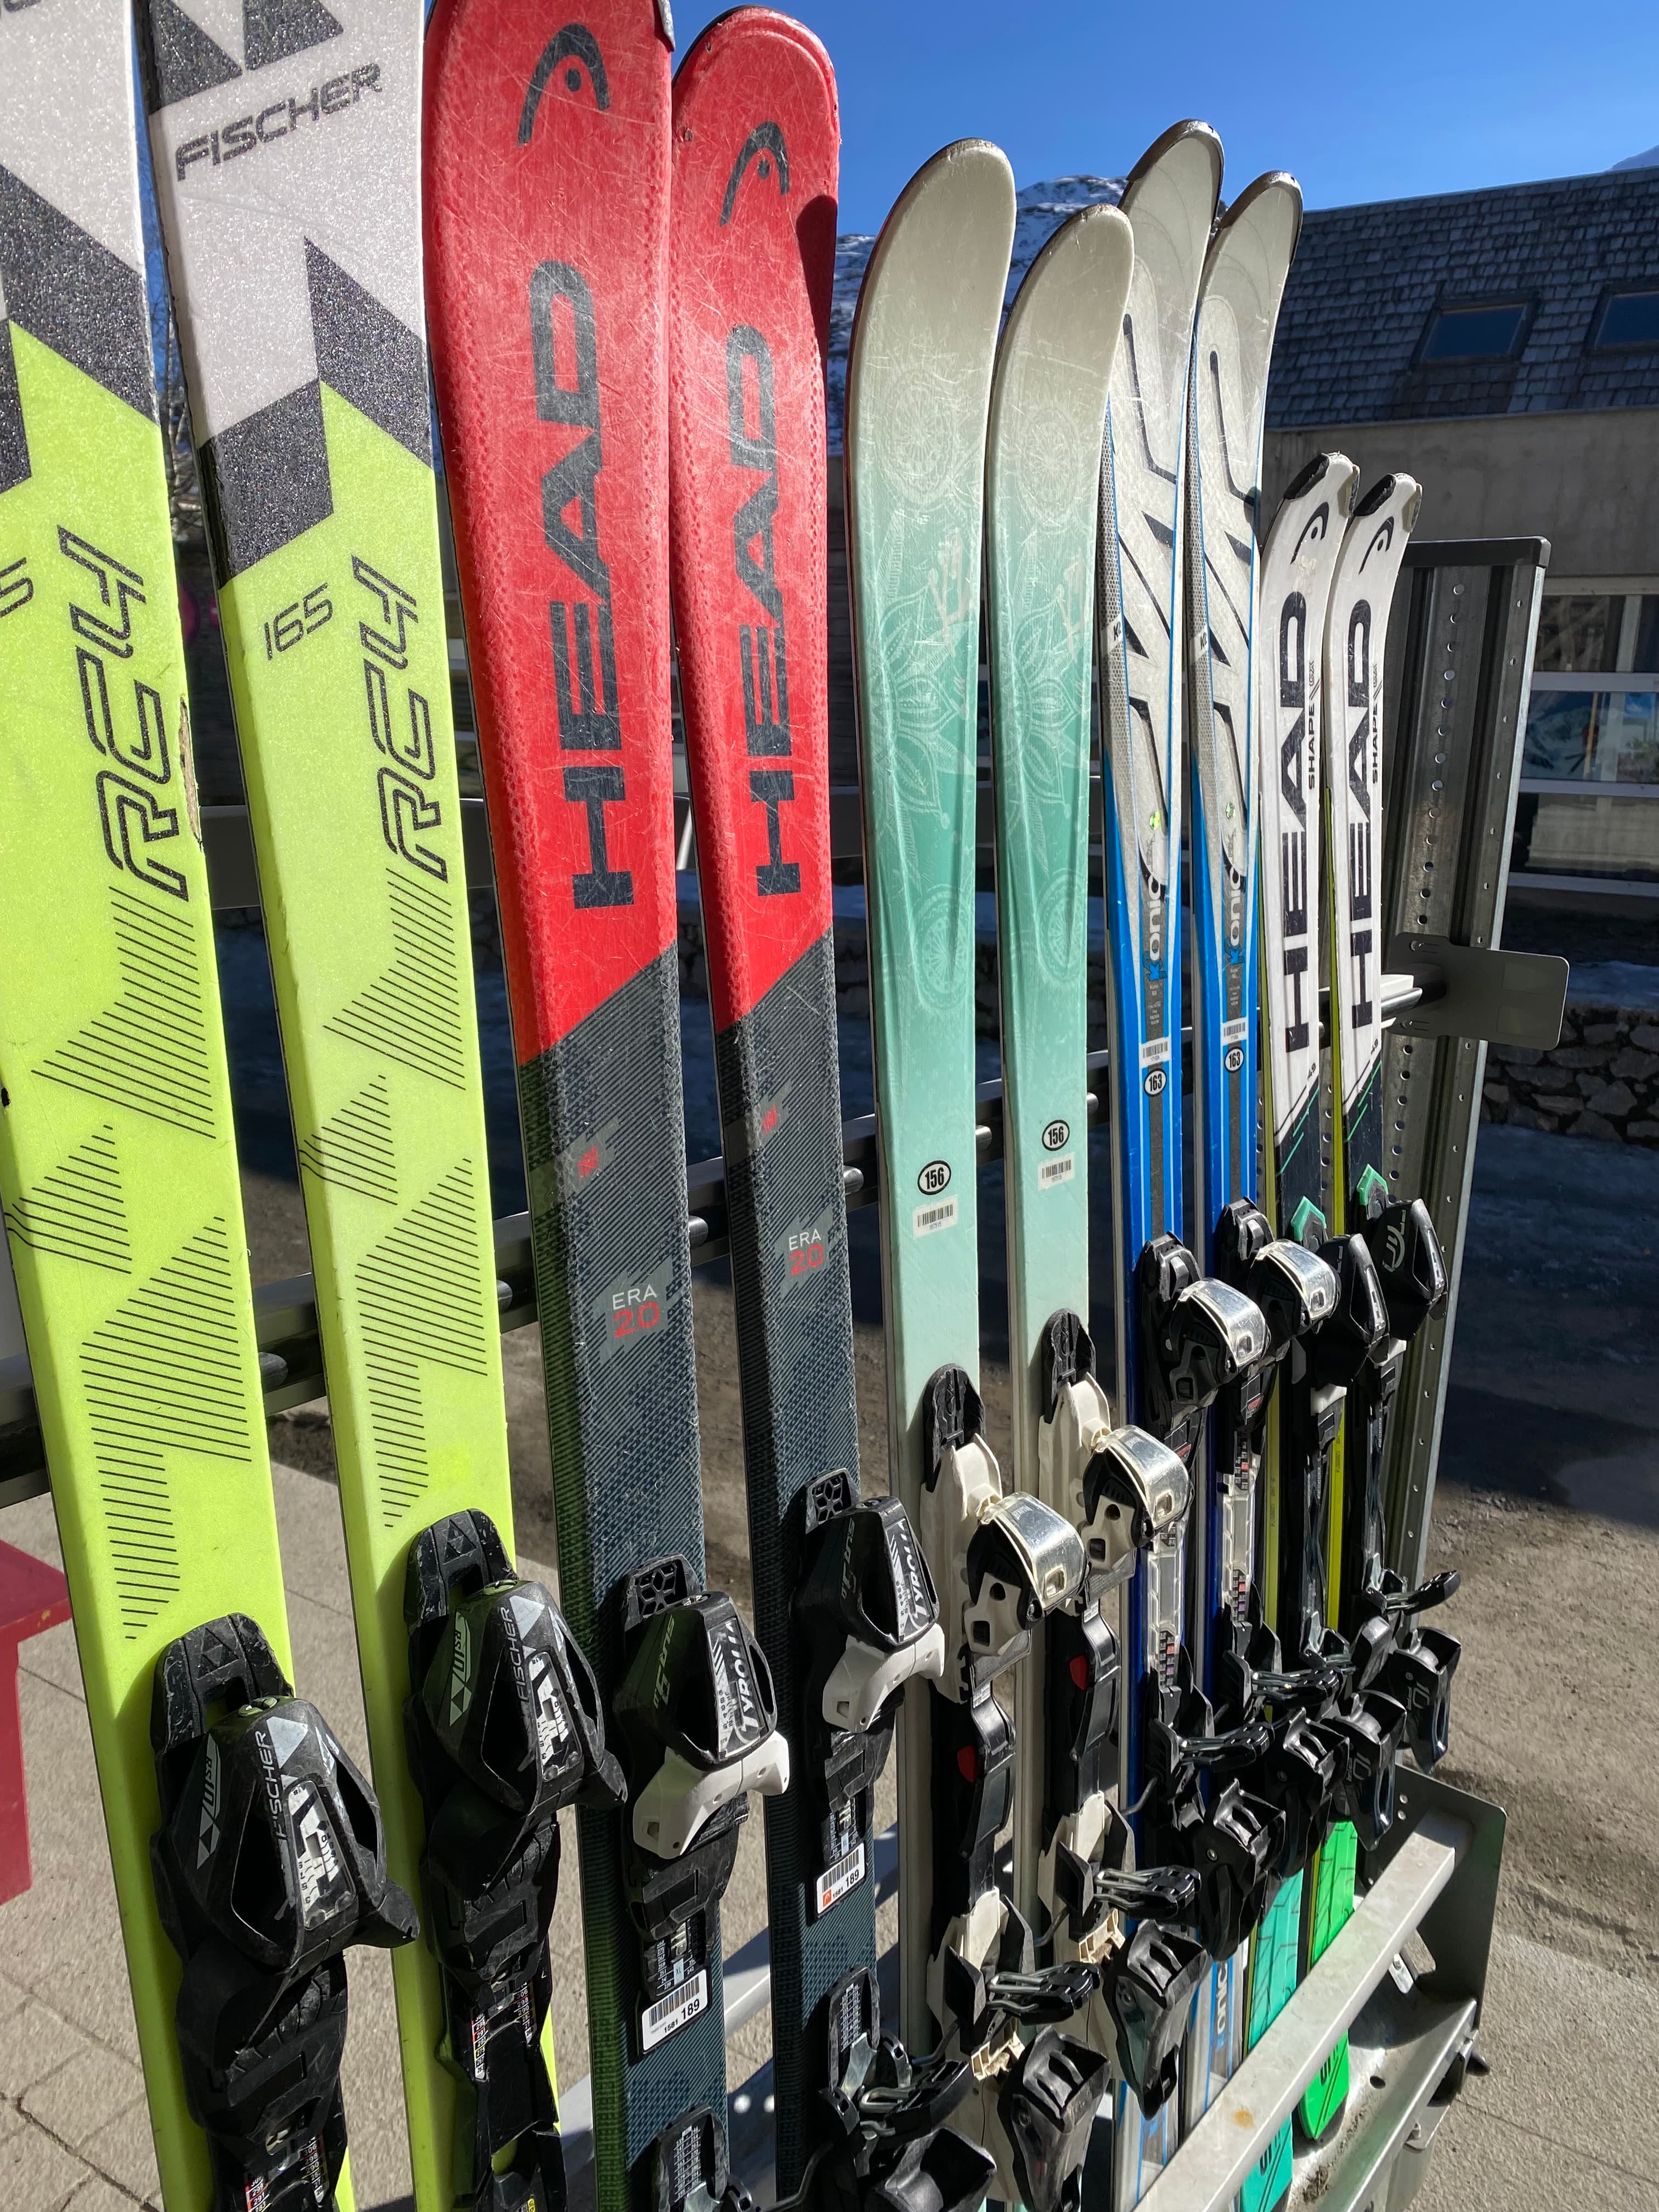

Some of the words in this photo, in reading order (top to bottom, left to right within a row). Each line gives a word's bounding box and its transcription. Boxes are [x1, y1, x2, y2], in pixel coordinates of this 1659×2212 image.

[175, 62, 383, 182] FISCHER
[529, 260, 635, 910] HEAD
[263, 582, 334, 661] 165
[725, 325, 802, 896] HEAD
[57, 524, 189, 902] RC4
[351, 554, 449, 883] RC4
[1279, 590, 1310, 1053] HEAD
[1347, 599, 1372, 1029] HEAD
[1228, 1051, 1240, 1068] 163
[1149, 1073, 1162, 1092] 163
[1047, 1125, 1064, 1146] 156
[924, 1166, 945, 1190] 156
[788, 1229, 822, 1252] ERA
[789, 1244, 825, 1276] 20
[612, 1284, 659, 1310] ERA
[613, 1301, 660, 1338] 20
[500, 1605, 528, 1701] FISCHER
[254, 1730, 288, 1841] FISCHER
[845, 1869, 859, 1888] 189
[516, 1989, 528, 2000] 306
[517, 1999, 529, 2008] 298
[517, 2005, 529, 2016] 290
[681, 1999, 700, 2020] 189
[303, 2143, 317, 2156] 306
[305, 2152, 319, 2165] 298
[306, 2160, 320, 2174] 290
[252, 2182, 263, 2197] 299
[253, 2192, 264, 2206] 291
